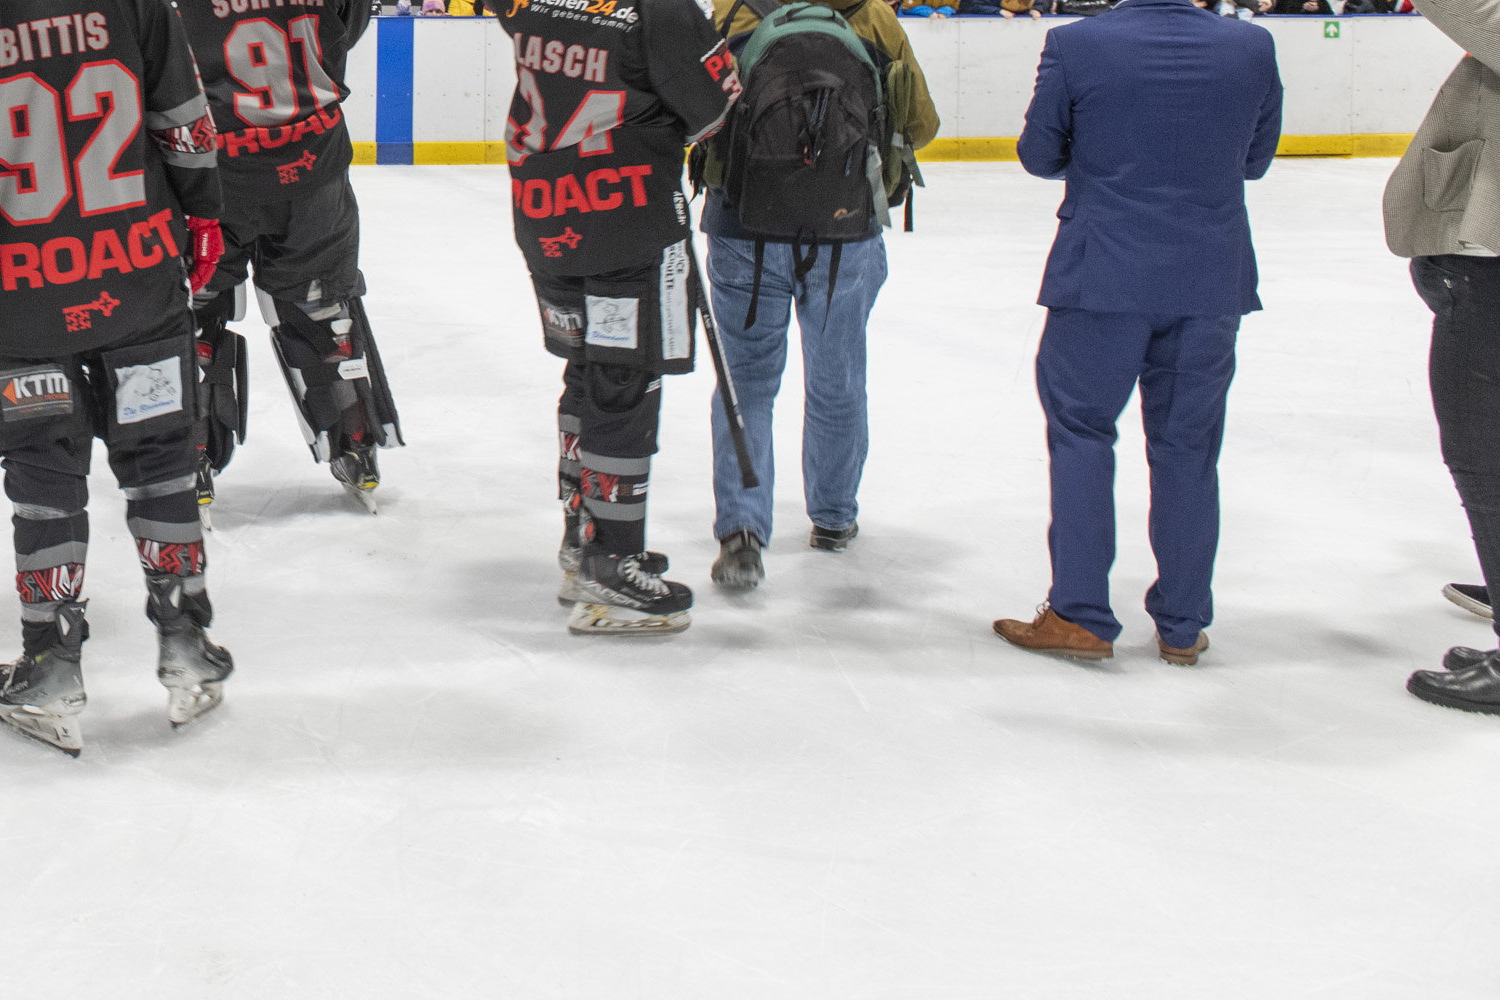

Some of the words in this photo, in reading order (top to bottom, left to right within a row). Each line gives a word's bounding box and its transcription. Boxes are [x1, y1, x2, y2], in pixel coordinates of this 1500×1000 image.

[530, 3, 550, 15] Wir
[551, 7, 589, 22] geben
[223, 14, 341, 128] 91
[512, 164, 653, 219] OACT
[13, 372, 69, 399] KTM
